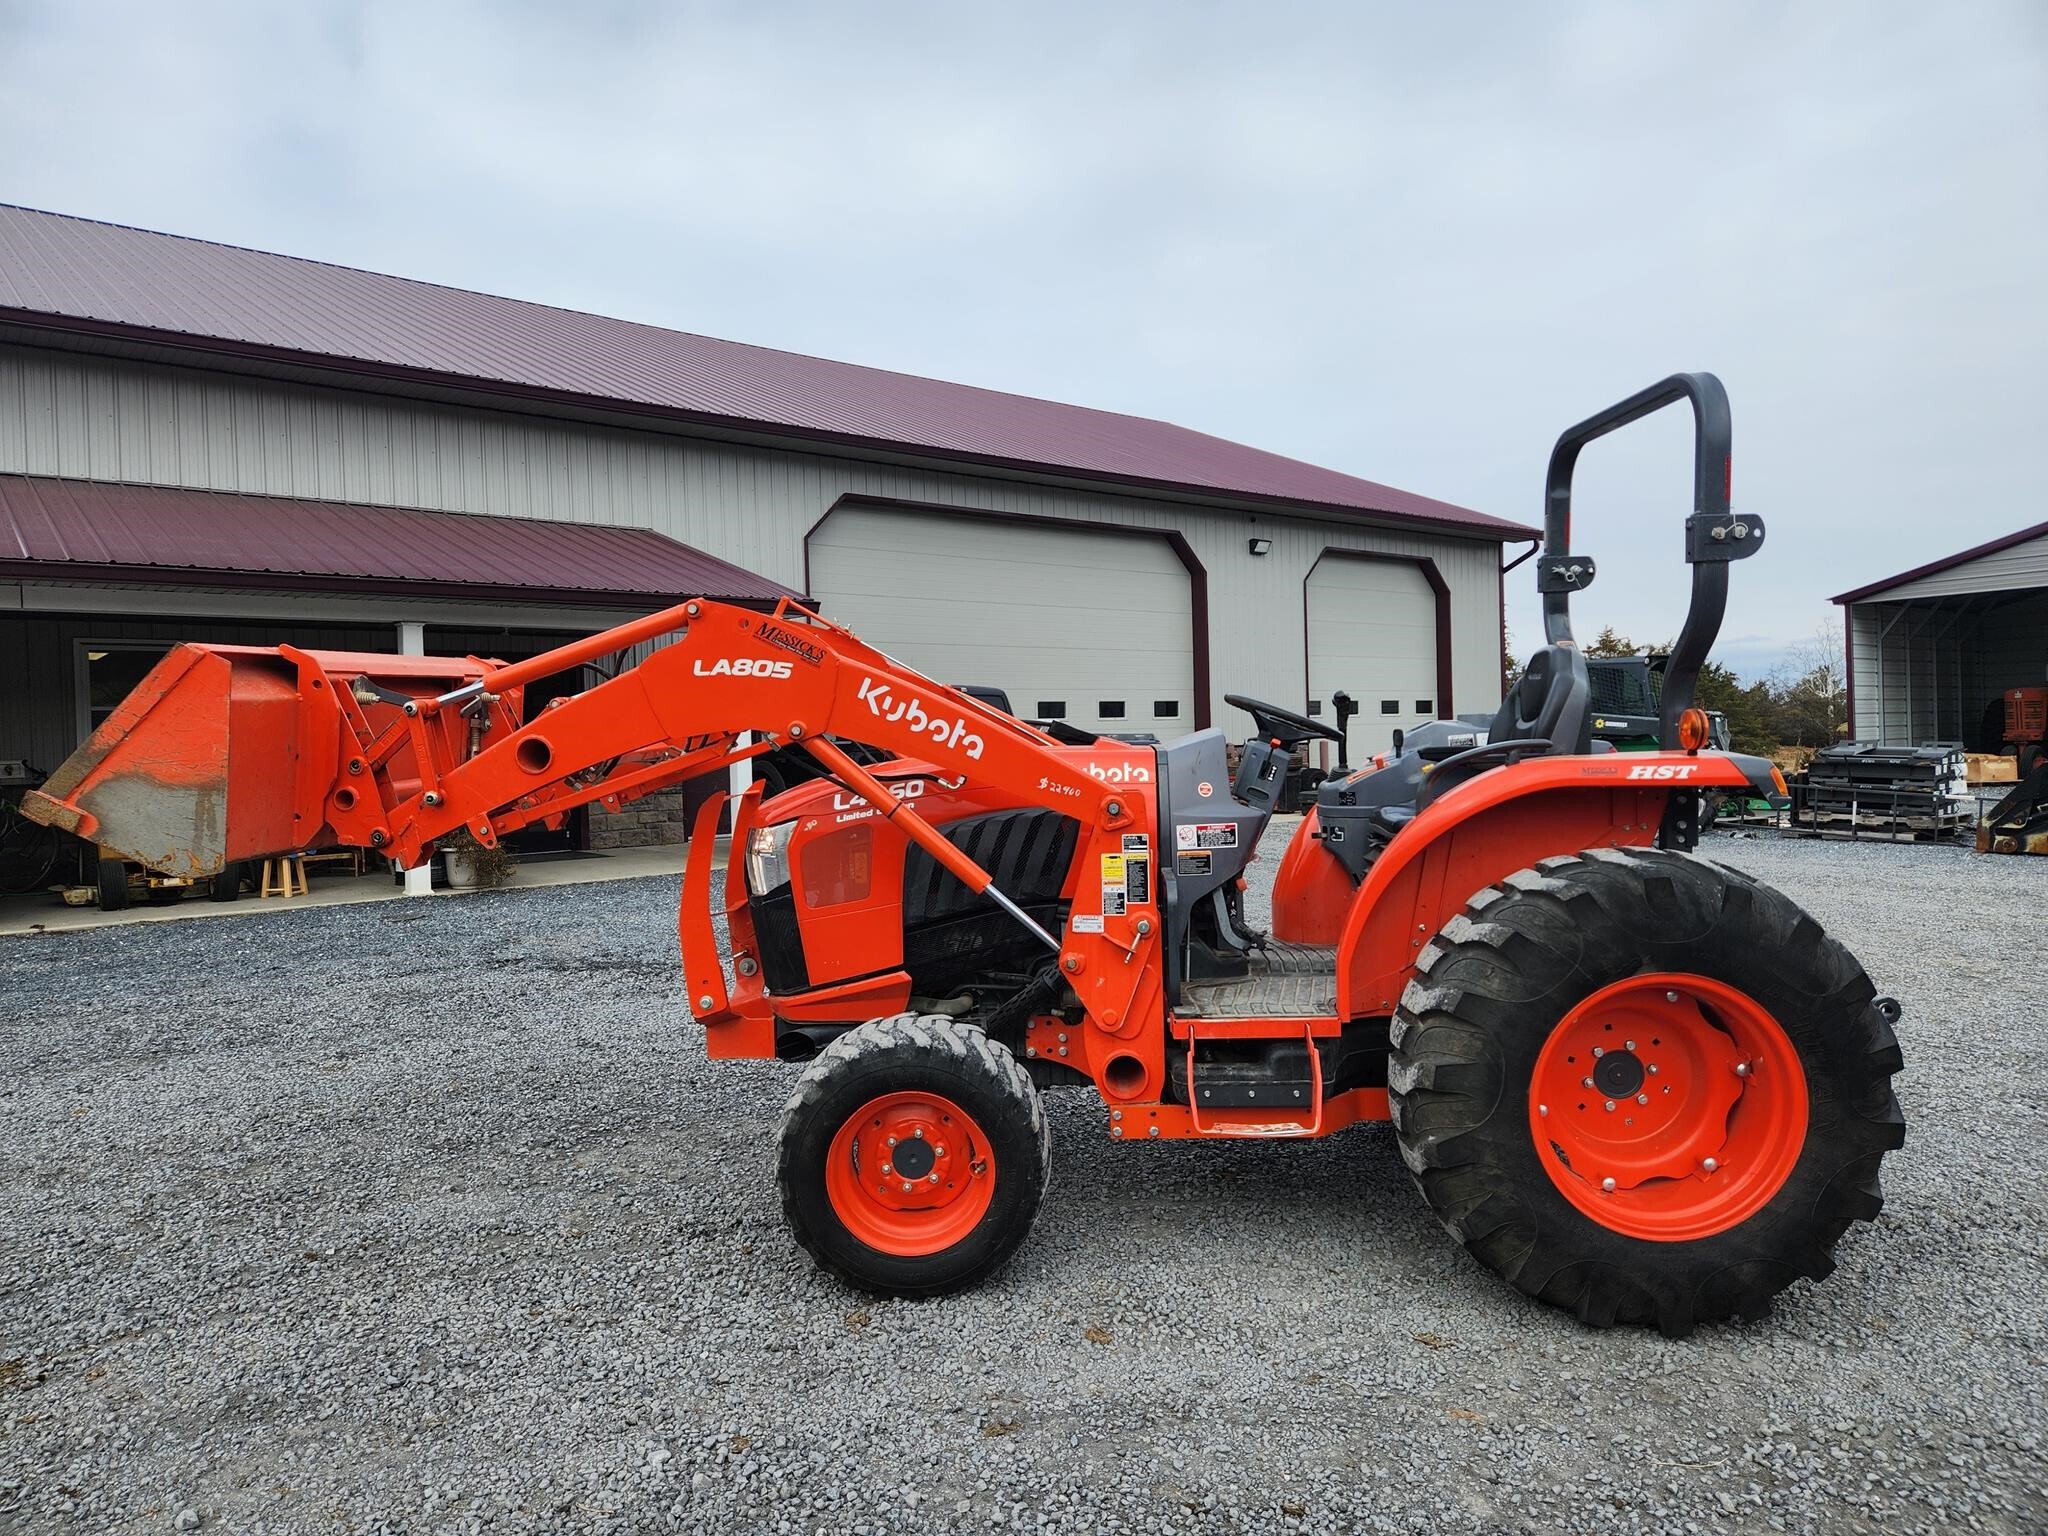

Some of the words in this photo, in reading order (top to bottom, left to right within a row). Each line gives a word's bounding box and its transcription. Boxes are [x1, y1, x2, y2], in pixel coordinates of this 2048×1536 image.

[755, 622, 828, 660] MESSICK'S
[692, 658, 795, 681] LA805
[857, 677, 985, 760] Kubota
[1626, 764, 1699, 781] HST
[833, 779, 925, 811] L460
[836, 808, 874, 823] Limited
